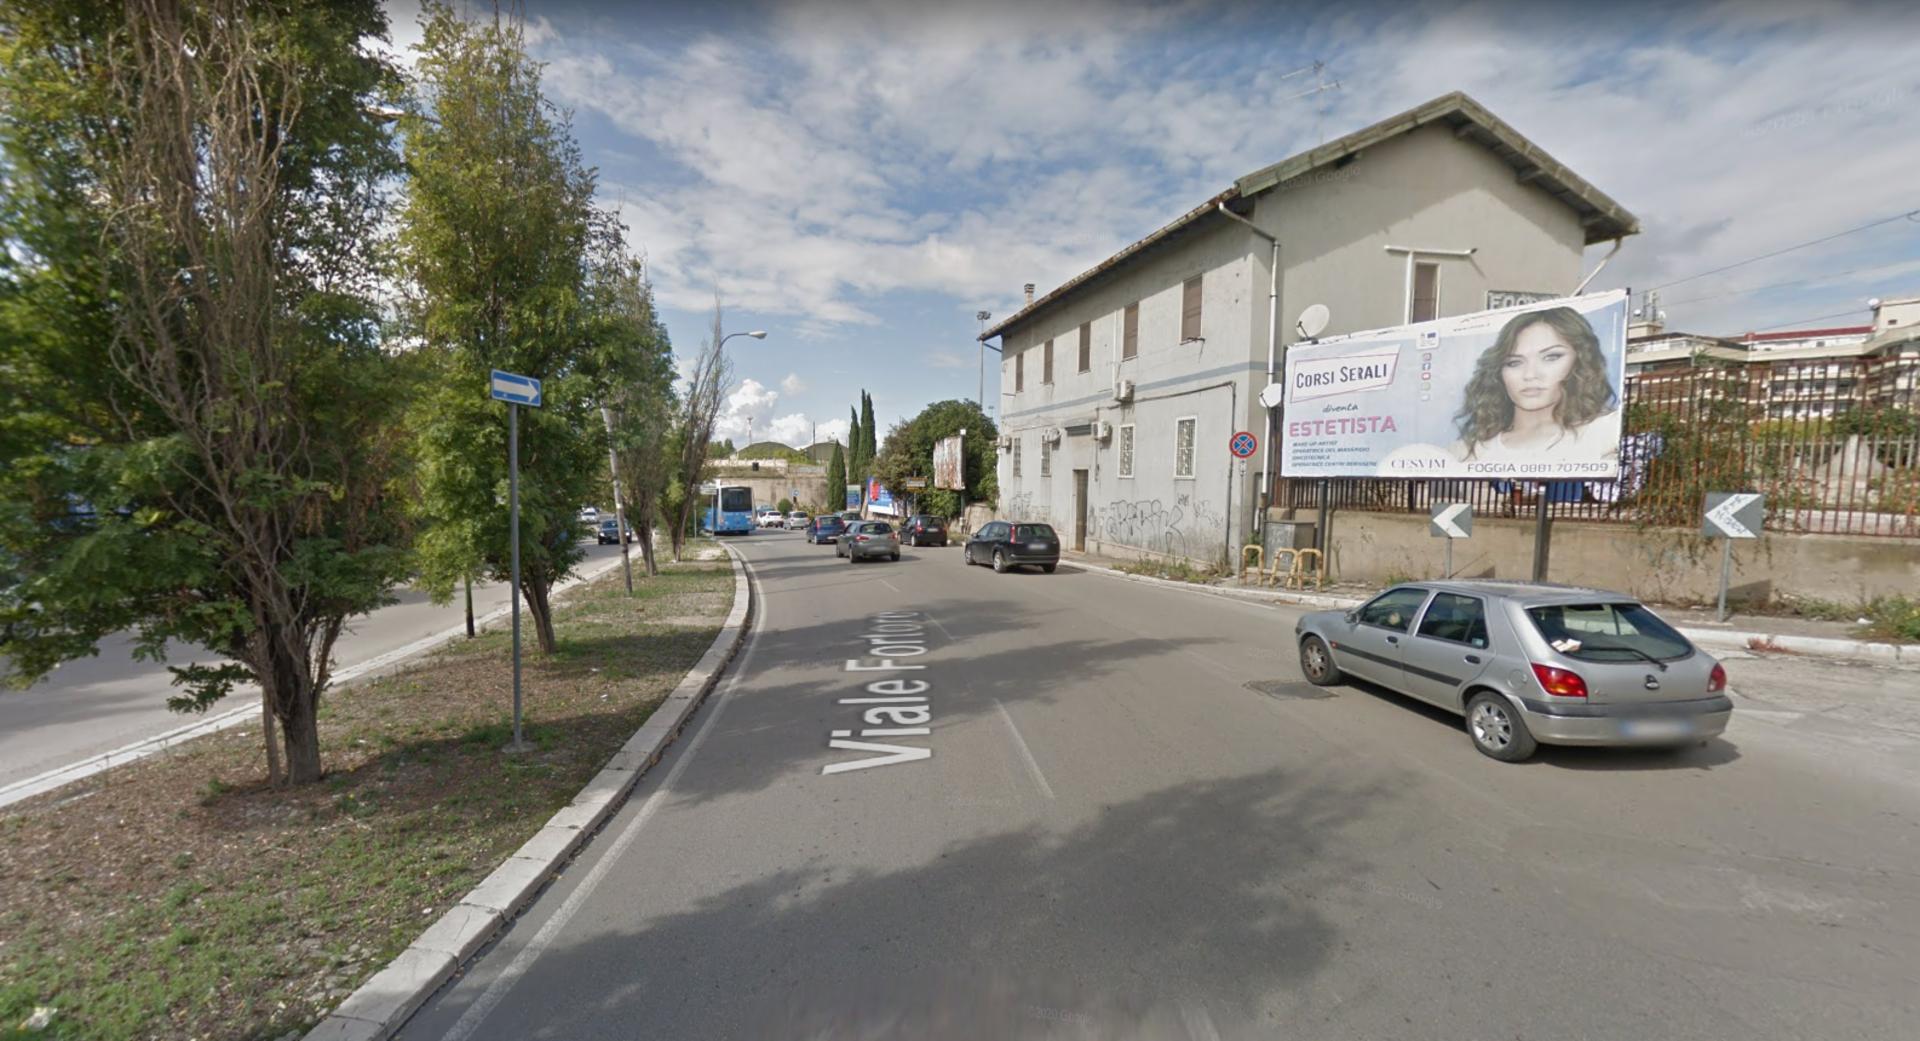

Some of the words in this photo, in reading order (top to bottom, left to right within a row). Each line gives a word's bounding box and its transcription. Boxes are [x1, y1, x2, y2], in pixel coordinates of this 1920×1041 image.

[1296, 371, 1334, 389] CORSI
[1340, 363, 1387, 383] SERALI
[1322, 403, 1359, 414] diventa
[1289, 415, 1397, 437] ESTETISTA
[1467, 462, 1516, 473] FOGGIA
[1520, 463, 1552, 473] 0881
[1556, 462, 1609, 473] 707509
